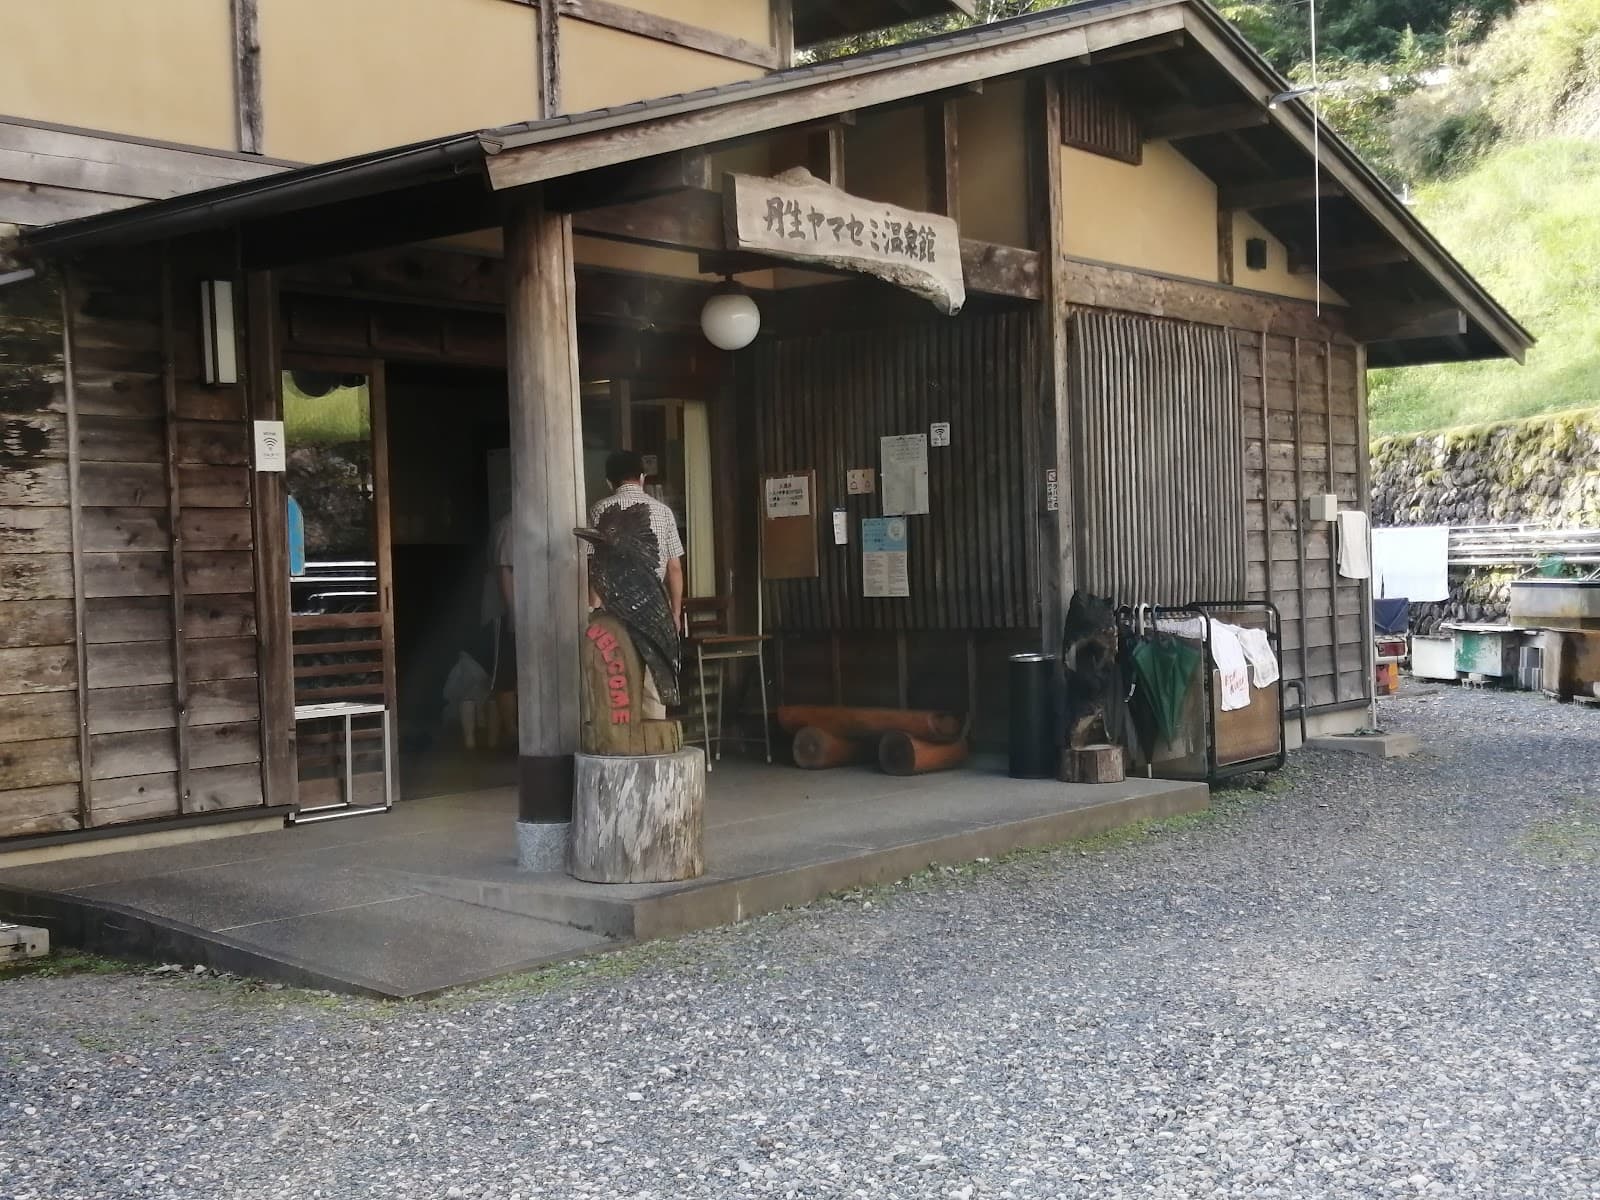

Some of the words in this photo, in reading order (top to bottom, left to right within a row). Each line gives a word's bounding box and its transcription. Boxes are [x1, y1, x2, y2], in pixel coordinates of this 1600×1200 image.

[763, 196, 936, 263] 丹生ヤマセミ温泉館
[586, 624, 630, 724] WELCOME
